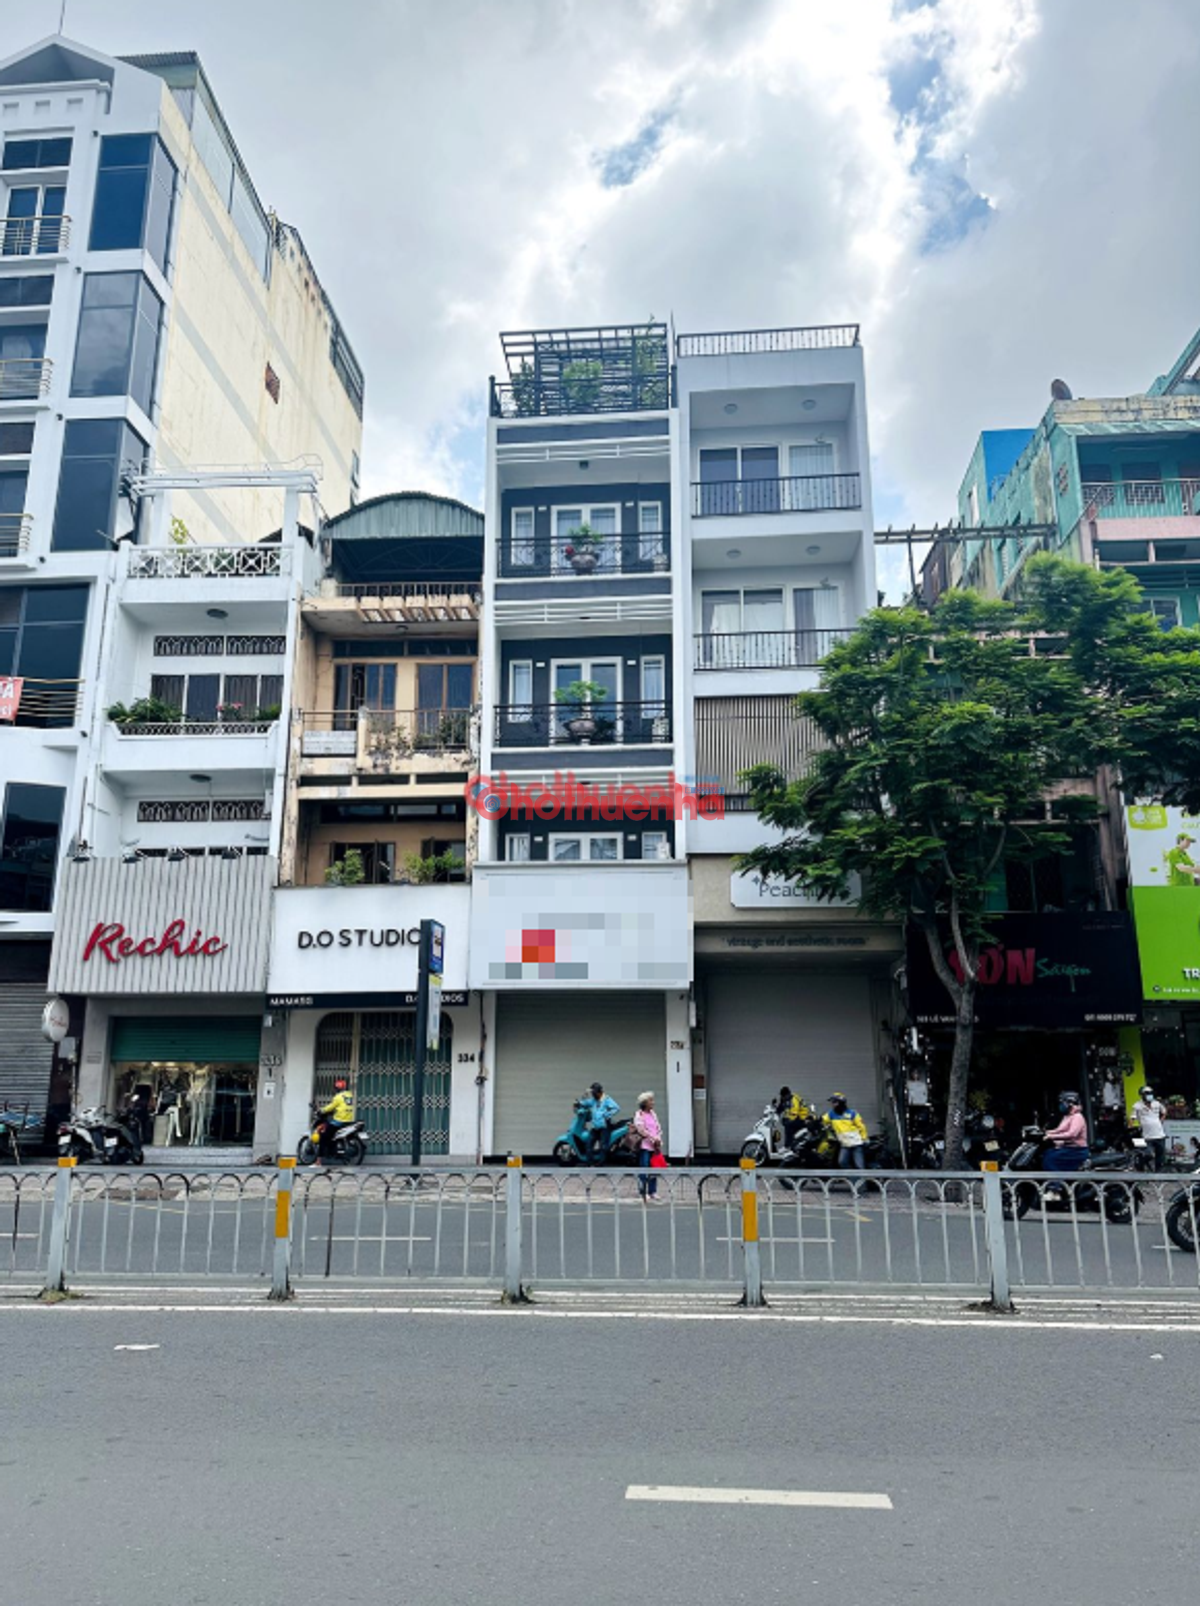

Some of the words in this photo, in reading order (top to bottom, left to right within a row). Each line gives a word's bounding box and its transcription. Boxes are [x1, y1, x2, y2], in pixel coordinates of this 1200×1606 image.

[83, 919, 228, 964] Rechic
[339, 927, 422, 948] STUDIO
[457, 1053, 475, 1064] 334
